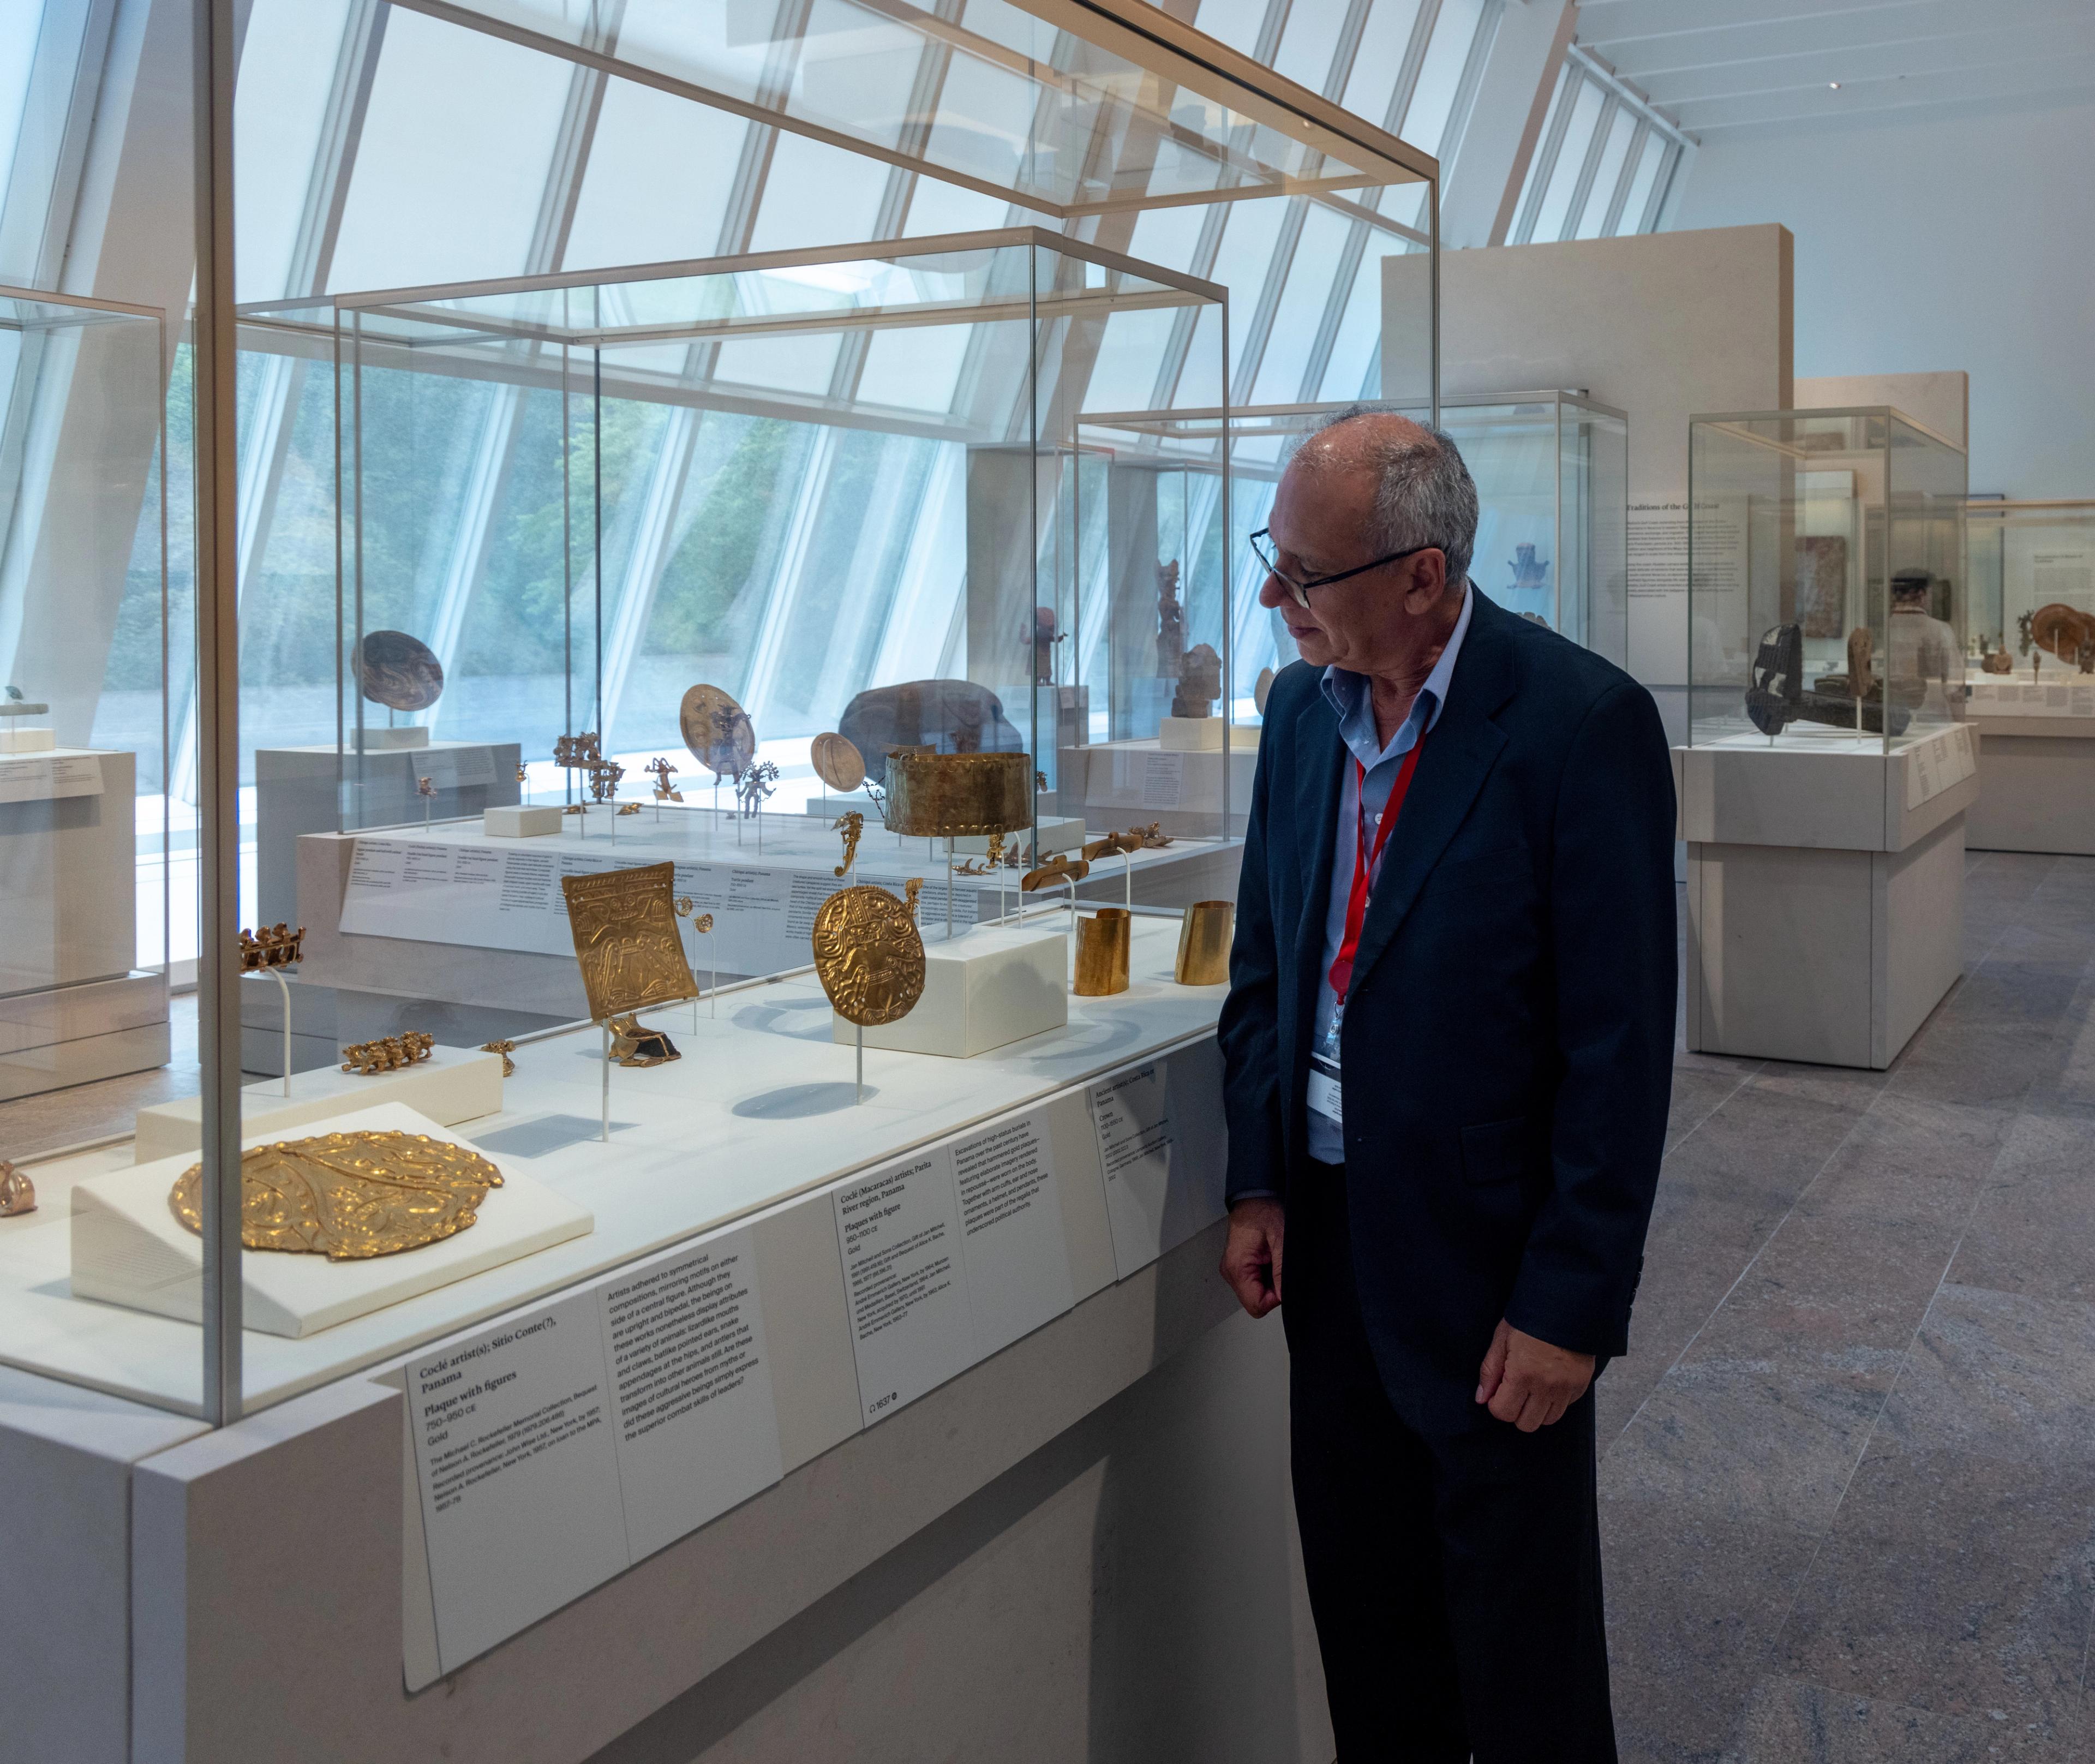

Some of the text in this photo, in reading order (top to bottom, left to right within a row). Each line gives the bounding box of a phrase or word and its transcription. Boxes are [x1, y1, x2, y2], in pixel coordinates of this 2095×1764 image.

[1096, 1087, 1111, 1098] Ancient
[1129, 1075, 1140, 1084] Costa
[1097, 1096, 1114, 1108] Panama
[1099, 1111, 1114, 1122] Crown
[955, 1141, 981, 1156] Excavations
[987, 1128, 1011, 1142] high-status
[1011, 1122, 1026, 1132] burials
[956, 1155, 974, 1165] Panama
[975, 1150, 984, 1158] over
[992, 1142, 1002, 1151] past
[1003, 1136, 1018, 1146] century
[1018, 1131, 1028, 1139] have
[1102, 1132, 1111, 1140] Gold
[958, 1162, 977, 1175] revealed
[977, 1159, 986, 1167] that
[986, 1148, 1010, 1163] hammered
[1010, 1144, 1020, 1154] gold
[959, 1146, 1037, 1185] featuring elaborate imagery rendered
[1000, 1169, 1011, 1177] worn
[840, 1191, 858, 1203] Coclé
[859, 1175, 893, 1197] (Macaracas)
[914, 1161, 931, 1173] Parita
[962, 1193, 981, 1205] Together
[1019, 1171, 1027, 1180] and
[1027, 1167, 1038, 1176] nose
[1008, 1186, 1016, 1195] and
[1037, 1173, 1048, 1181] these
[842, 1203, 858, 1215] River
[881, 1184, 905, 1198] Panama
[845, 1204, 900, 1233] Plaques with figure
[966, 1217, 995, 1235] underscored
[995, 1209, 1011, 1223] political
[847, 1244, 860, 1255] Gold
[607, 1287, 630, 1301] Artists
[631, 1273, 660, 1291] adhered
[669, 1254, 708, 1276] symmetrical
[658, 1276, 689, 1293] mirroring
[690, 1267, 710, 1280] motifs
[710, 1263, 719, 1271] on
[720, 1255, 738, 1267] either
[610, 1315, 625, 1326] side
[627, 1310, 634, 1319] of
[641, 1297, 665, 1313] central
[687, 1277, 716, 1294] Although
[716, 1271, 730, 1281] they
[612, 1330, 624, 1339] are
[625, 1318, 649, 1334] upright
[650, 1311, 663, 1323] and
[690, 1296, 701, 1305] the
[702, 1287, 723, 1300] beings
[724, 1282, 732, 1290] on
[614, 1288, 747, 1352] these works nonetheless display attributes
[615, 1355, 622, 1364] of
[628, 1344, 651, 1358] variety
[652, 1338, 659, 1348] of
[687, 1315, 715, 1332] lizardlike
[715, 1305, 739, 1319] mouths
[420, 1359, 447, 1378] Coclé
[492, 1335, 513, 1349] Sitio
[617, 1365, 630, 1377] and
[654, 1346, 676, 1360] batlike
[677, 1332, 702, 1351] pointed
[720, 1317, 739, 1330] snake
[421, 1371, 462, 1394] Panama
[424, 1371, 516, 1417] Plaque with figures
[623, 1358, 758, 1428] did these aggressive beings simply express
[465, 1403, 476, 1414] CE
[625, 1431, 636, 1441] the
[637, 1416, 666, 1435] superior
[667, 1402, 692, 1420] combat
[693, 1395, 709, 1407] skills
[710, 1389, 716, 1398] of
[876, 1395, 890, 1409] 1637
[427, 1430, 448, 1445] Gold
